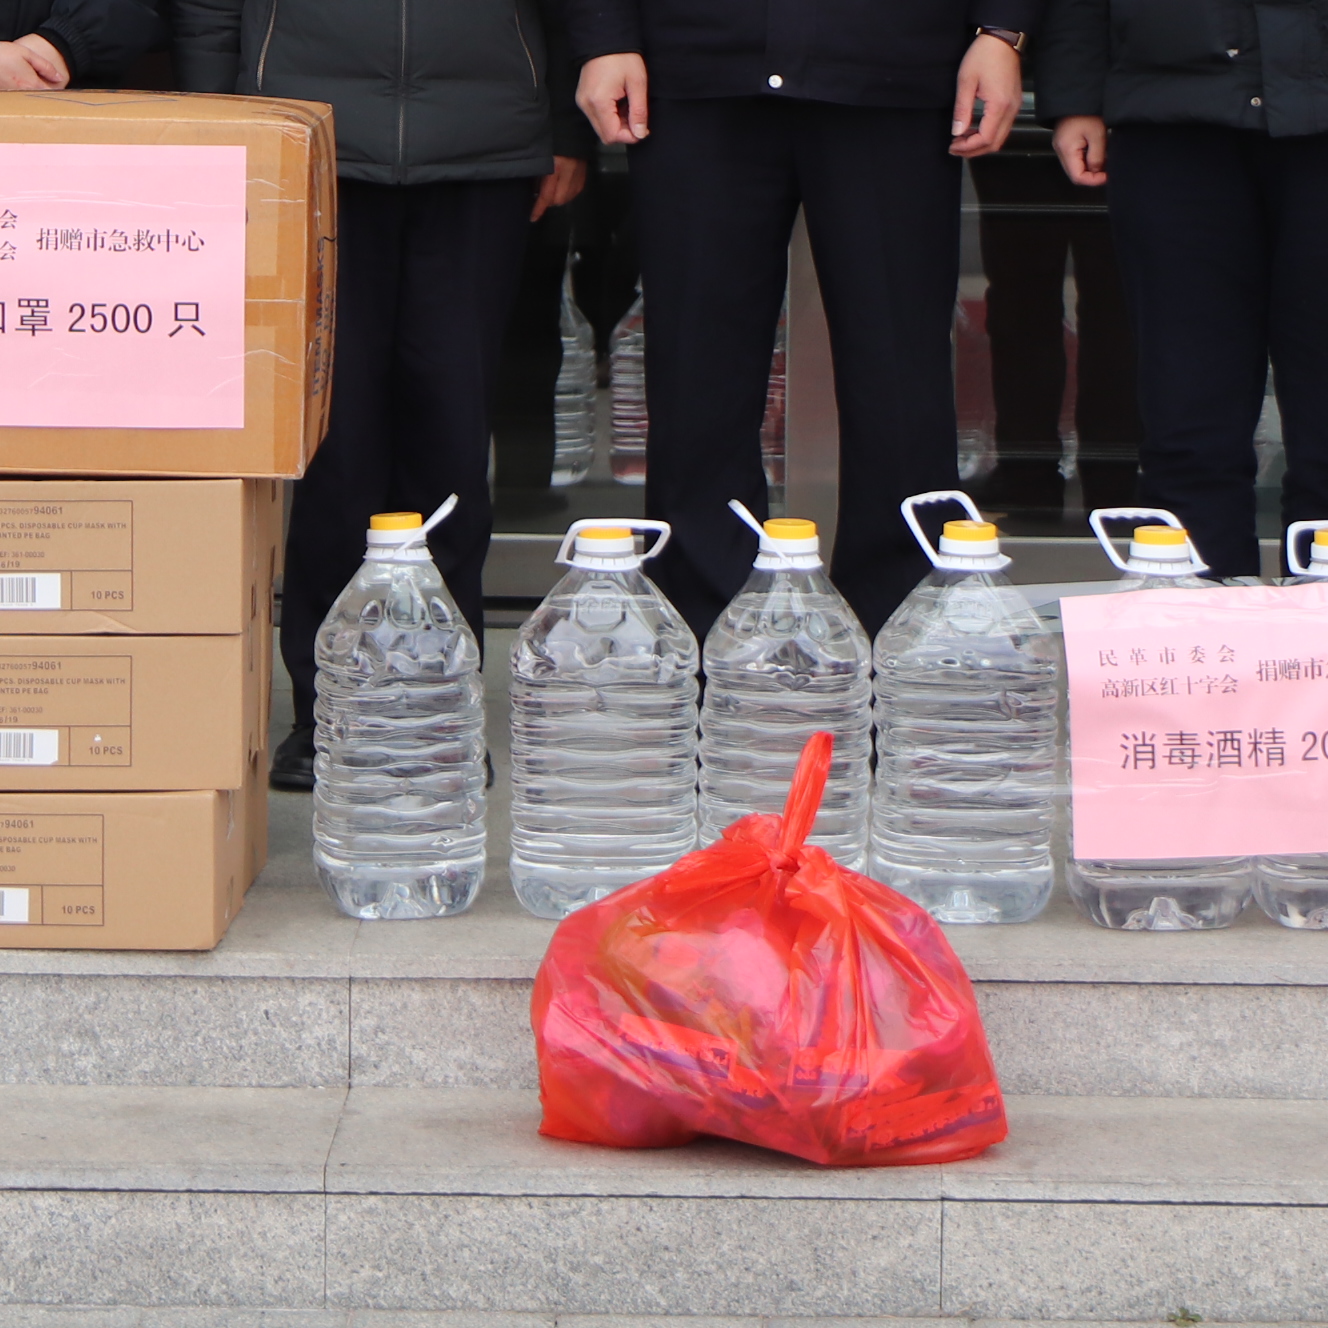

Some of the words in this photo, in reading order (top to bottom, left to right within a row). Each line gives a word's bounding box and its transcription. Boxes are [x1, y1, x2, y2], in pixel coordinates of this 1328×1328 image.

[35, 227, 205, 253] 捐赠市急救中心
[67, 303, 153, 334] 2500
[168, 301, 206, 338] 只
[91, 591, 102, 599] 10
[105, 591, 124, 599] PCS
[1098, 645, 1235, 668] 民革市委会
[1102, 675, 1238, 699] 高新区红十字会
[89, 746, 100, 755] 10
[103, 746, 123, 755] PCS
[1120, 727, 1287, 770] 消毒酒精
[62, 906, 73, 914] 10
[76, 906, 95, 914] PCS
